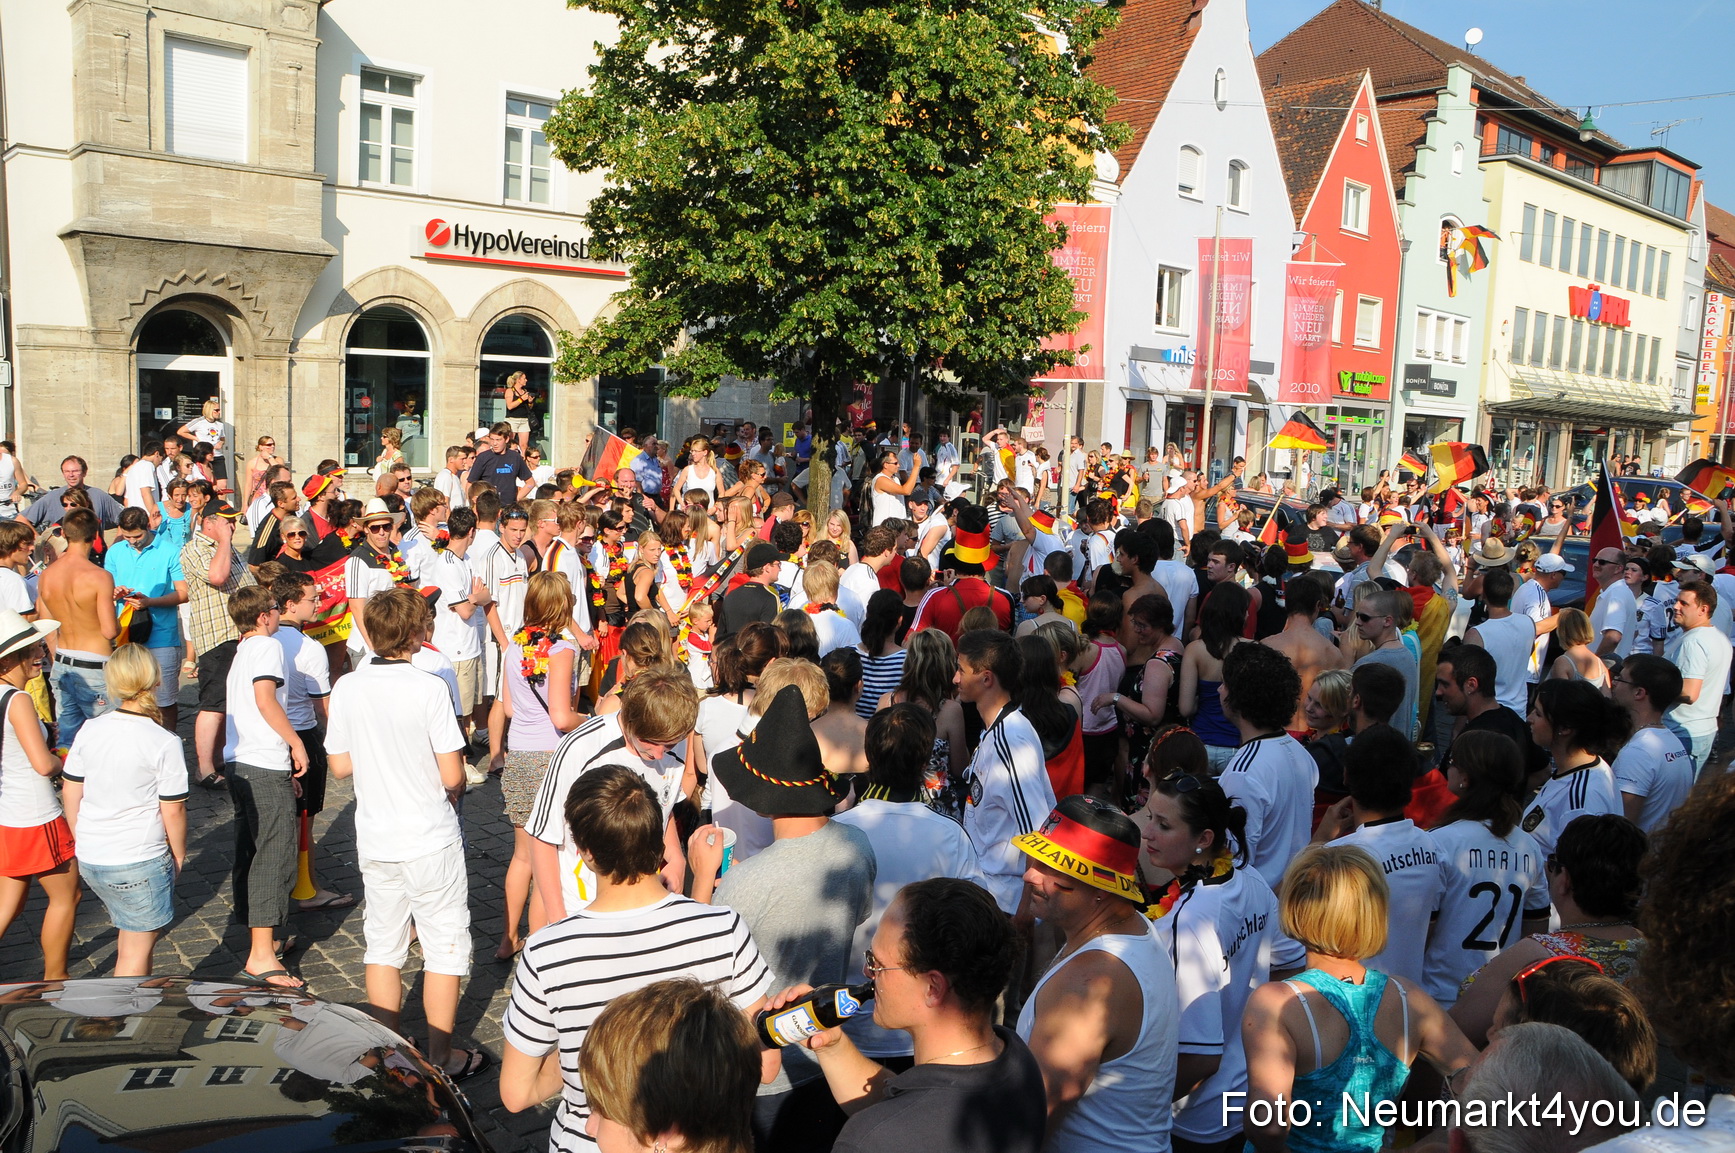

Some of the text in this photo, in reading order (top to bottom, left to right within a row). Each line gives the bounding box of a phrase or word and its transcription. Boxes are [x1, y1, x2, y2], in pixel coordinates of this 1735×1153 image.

[1072, 221, 1107, 233] feiern
[454, 222, 625, 262] HypoVereinsbk
[1055, 256, 1095, 266] IMMER
[1073, 278, 1093, 292] EU
[1288, 275, 1335, 287] Wir feiern
[1073, 293, 1092, 303] RKT
[1294, 303, 1325, 313] IMMER
[1292, 312, 1325, 322] WIEDER
[1294, 321, 1322, 333] NEU
[1294, 333, 1322, 343] MARKT
[1405, 377, 1427, 385] BONITA
[1290, 382, 1321, 394] 2010
[337, 622, 352, 632] THE
[1019, 832, 1089, 877] CHLAND
[1382, 846, 1438, 875] utschlan
[1469, 848, 1530, 874] MARIN
[1461, 881, 1523, 951] 21
